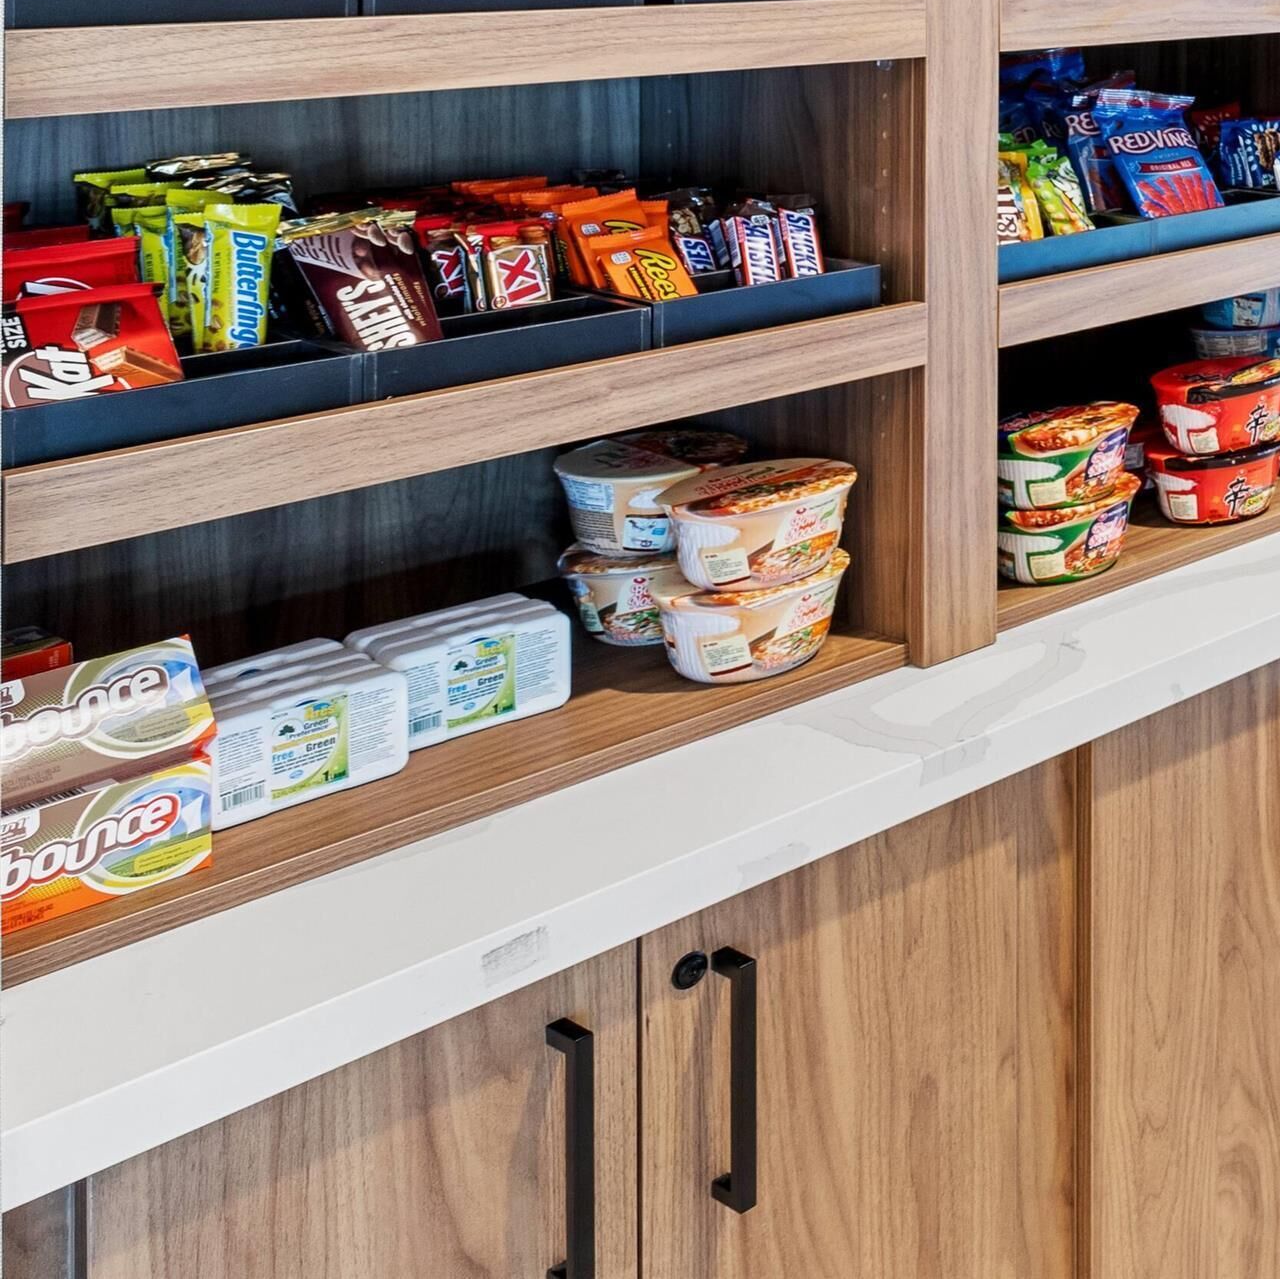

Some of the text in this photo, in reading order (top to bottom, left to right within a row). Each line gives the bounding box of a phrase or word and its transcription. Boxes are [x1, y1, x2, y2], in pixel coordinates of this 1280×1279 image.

[785, 211, 818, 275] SNICKE
[230, 230, 268, 349] Butterfing
[1247, 404, 1269, 443] 辛
[1224, 477, 1251, 517] 辛
[272, 737, 336, 763] Free Green
[1, 794, 181, 902] bounce
